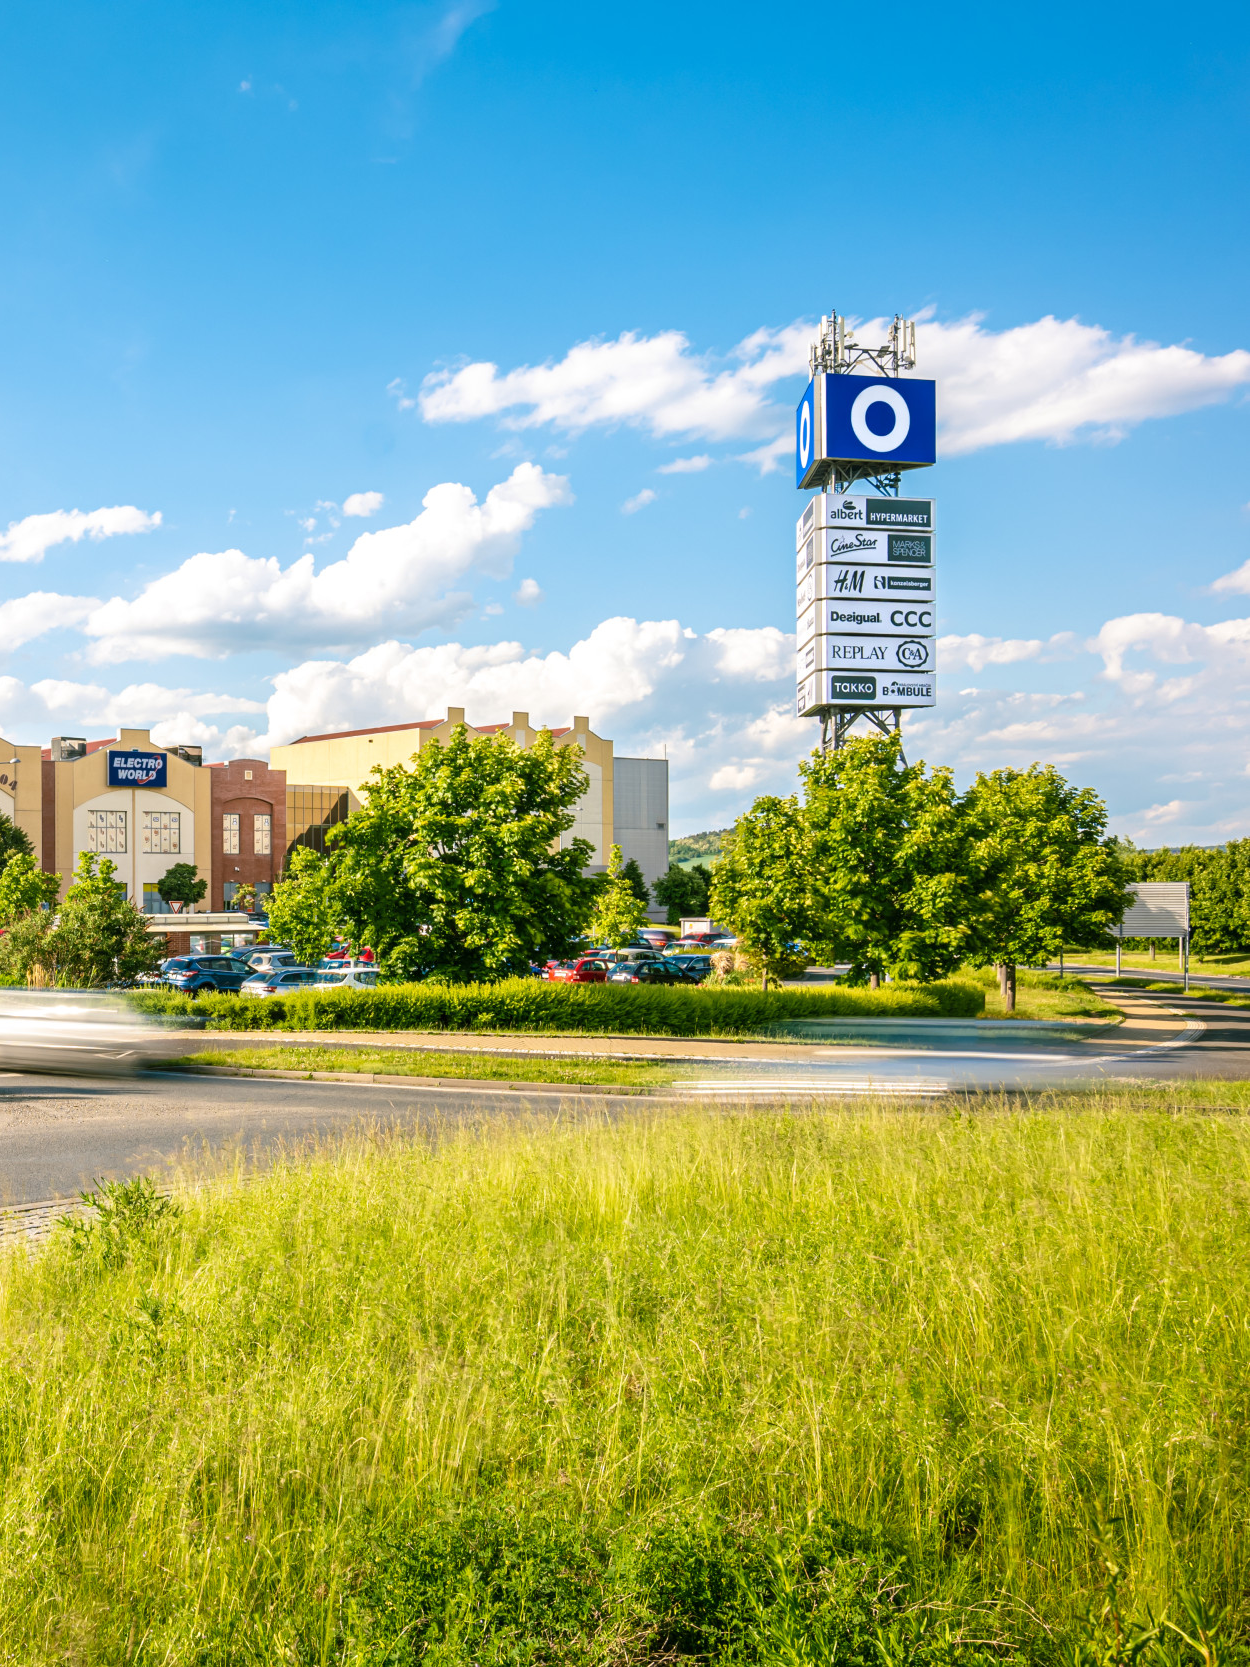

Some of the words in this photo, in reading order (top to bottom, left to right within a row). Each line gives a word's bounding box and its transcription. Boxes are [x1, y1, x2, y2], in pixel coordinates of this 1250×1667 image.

[831, 509, 863, 520] albert
[870, 512, 928, 523] HYPERMARKET
[831, 534, 877, 552] CineStar
[893, 548, 925, 556] SPENCER
[834, 570, 866, 593] H&M
[890, 610, 932, 627] CCC
[832, 645, 888, 659] REPLAY
[902, 648, 923, 660] C&A
[113, 758, 163, 769] ELECTRO
[118, 769, 156, 780] WORLD
